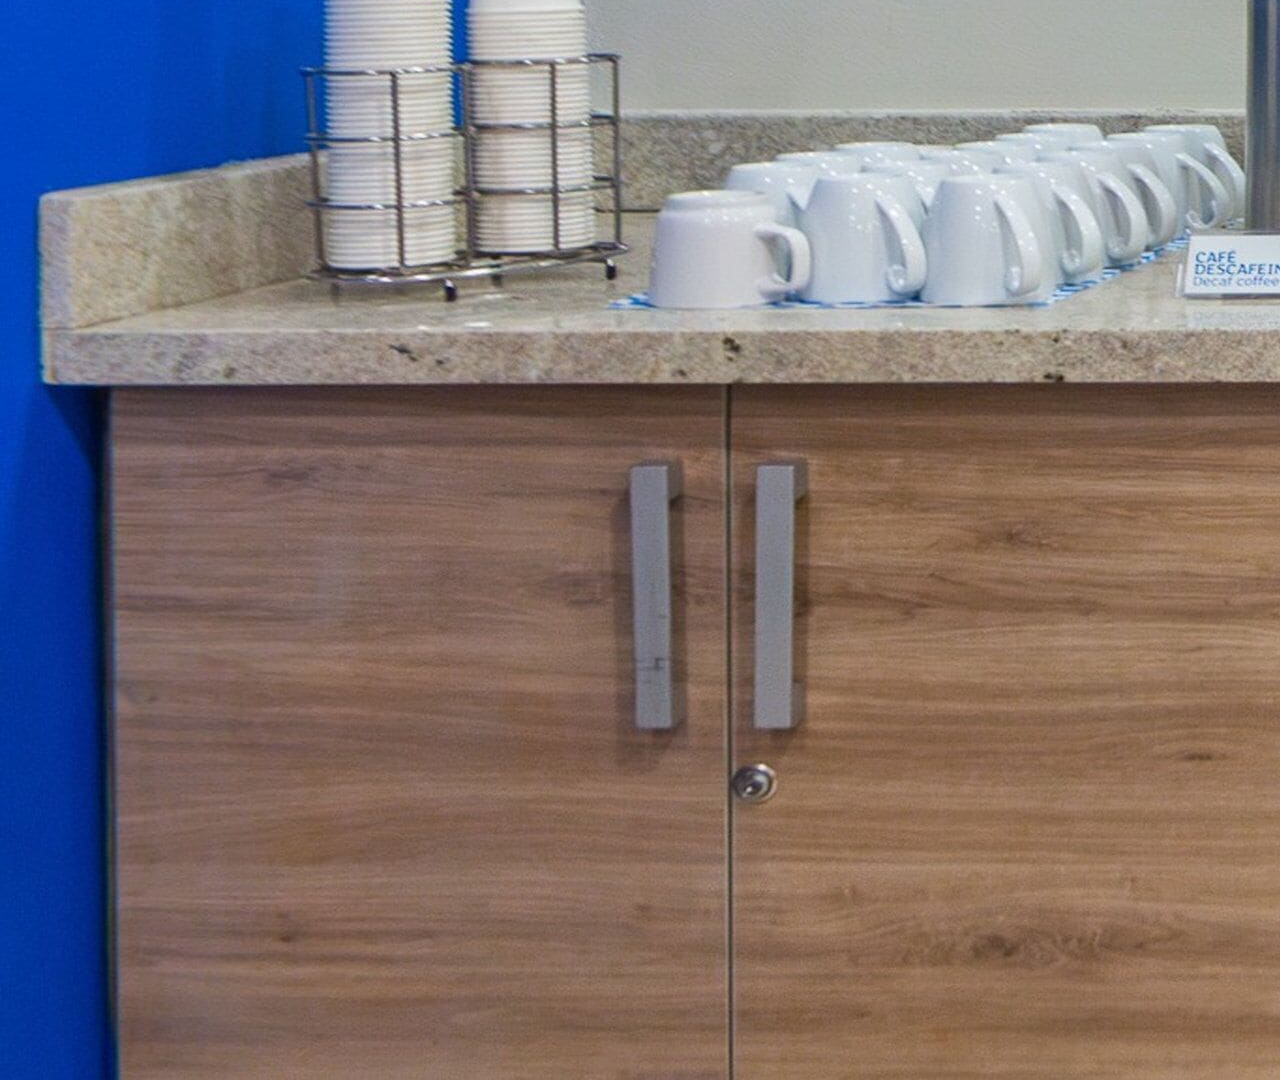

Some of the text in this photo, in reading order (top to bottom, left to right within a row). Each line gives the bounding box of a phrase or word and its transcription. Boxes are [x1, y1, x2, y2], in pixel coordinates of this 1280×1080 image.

[1195, 251, 1237, 263] CAFÉ
[1193, 276, 1280, 287] Decaf coffee
